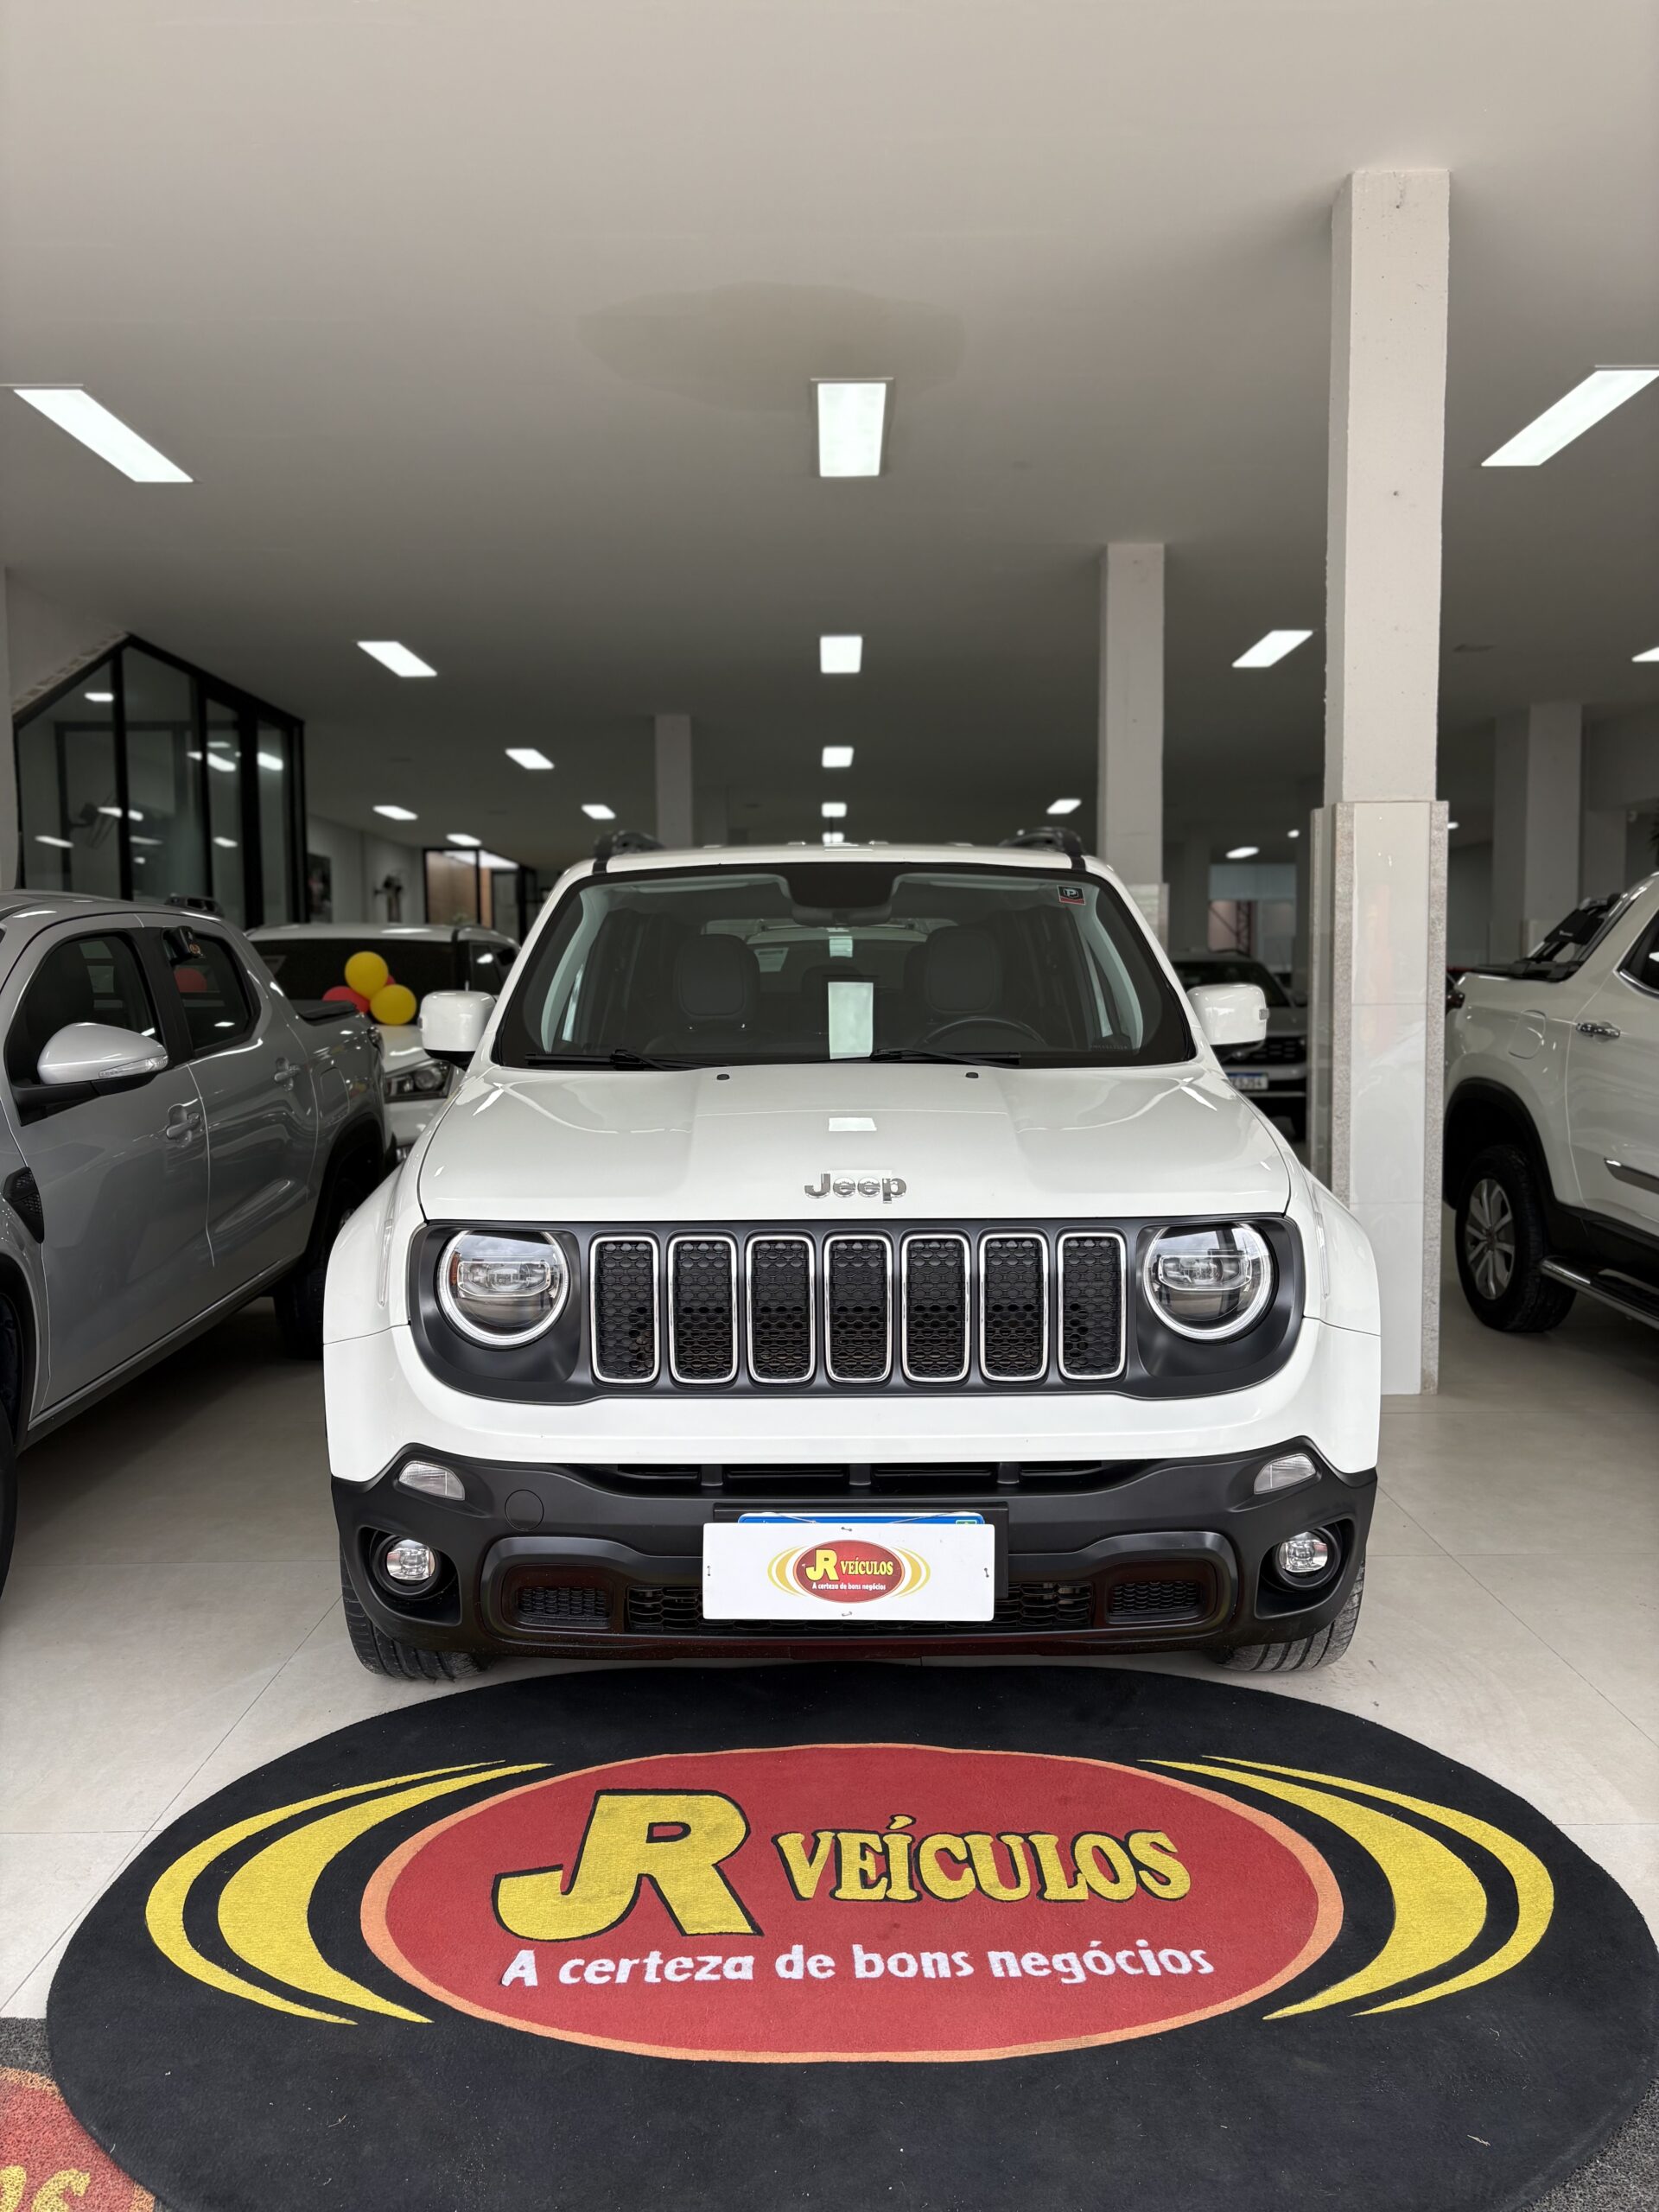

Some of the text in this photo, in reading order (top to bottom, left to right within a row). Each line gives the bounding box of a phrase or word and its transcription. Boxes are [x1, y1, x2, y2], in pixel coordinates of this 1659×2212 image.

[804, 1173, 907, 1205] Jeep
[804, 1548, 894, 1582] JR VEÍCULOS
[491, 1788, 1192, 1942] JR VEÍCULOS
[500, 1939, 1216, 1987] A certeza de bons negócios
